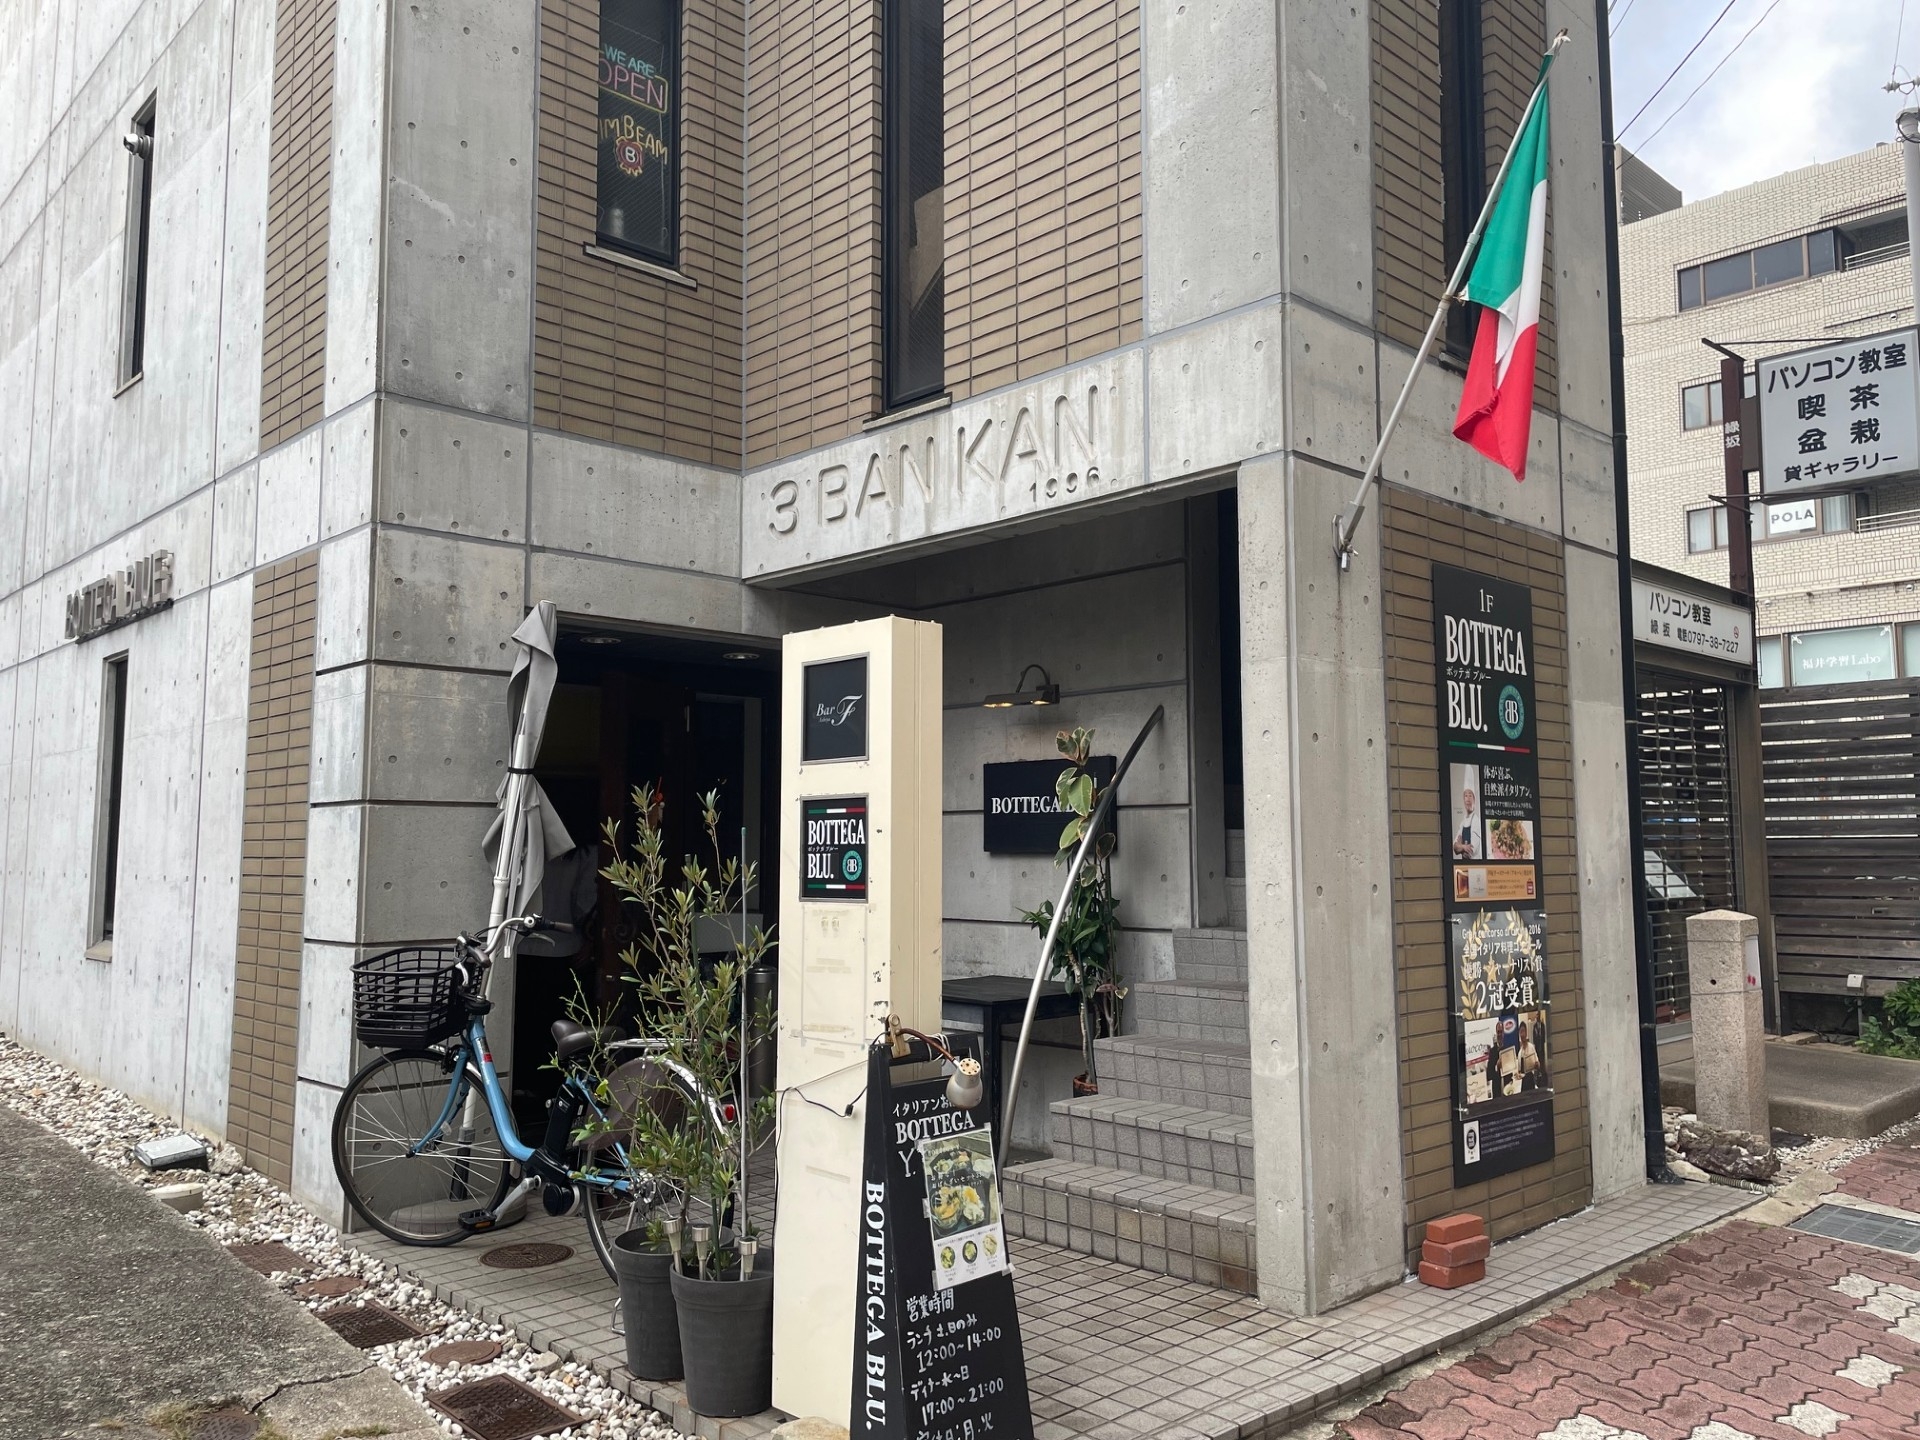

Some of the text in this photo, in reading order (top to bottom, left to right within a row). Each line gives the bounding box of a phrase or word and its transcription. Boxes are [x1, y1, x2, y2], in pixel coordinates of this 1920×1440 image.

[604, 43, 655, 79] WE ARE
[598, 58, 664, 109] OPEN
[600, 115, 668, 165] IM BEAM
[1768, 343, 1907, 393] パソコン教室
[1784, 452, 1899, 483] 貸ギャラリー
[768, 479, 800, 535] 3
[1771, 508, 1814, 524] POLA
[1479, 588, 1494, 613] 1F
[1650, 591, 1712, 626] パソコン教室
[1444, 615, 1528, 676] BOTTEGA
[1446, 666, 1492, 682] ボッテガ ブルー
[816, 703, 836, 717] Bar
[1447, 680, 1488, 733] BLU.
[991, 795, 1062, 814] BOTTEGA
[1484, 782, 1533, 799] 自然派イタリアン。
[807, 819, 866, 846] BOTTEGA
[807, 853, 835, 879] BLU.
[1478, 927, 1503, 939] cocorso
[1528, 923, 1542, 935] 2016
[1476, 976, 1535, 1014] 2冠受賞
[893, 1094, 955, 1117] イタリアンお
[895, 1110, 976, 1145] BOTTEGA
[865, 1180, 886, 1431] BOTTEGA BLU.
[906, 1288, 954, 1322] 営業時間
